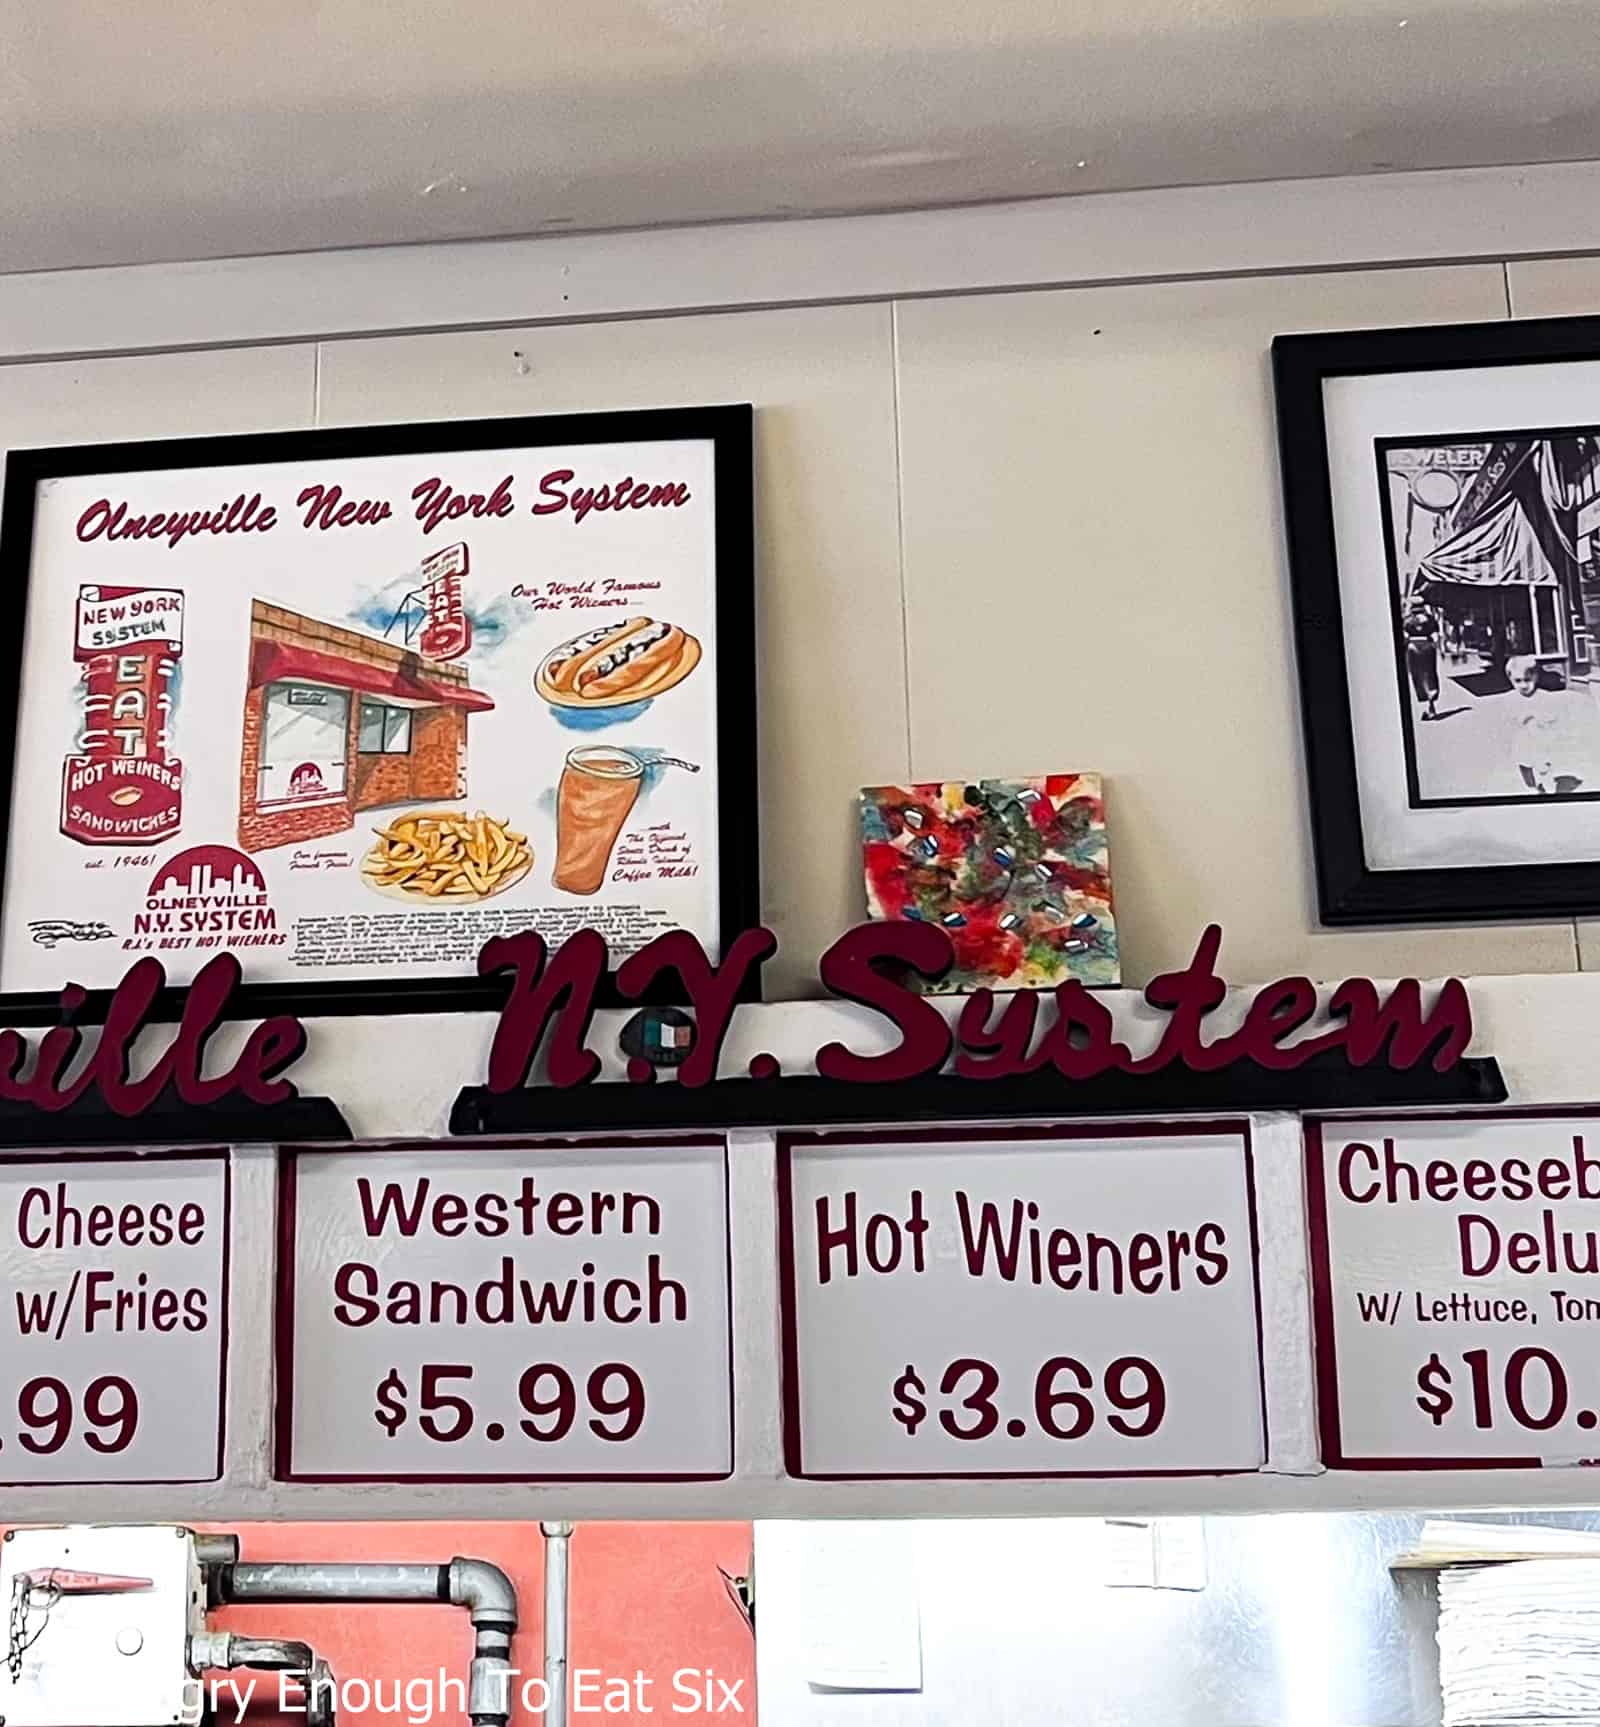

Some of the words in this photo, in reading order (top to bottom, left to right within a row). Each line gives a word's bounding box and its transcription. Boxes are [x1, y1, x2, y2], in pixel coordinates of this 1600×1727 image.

[76, 493, 277, 548] Olneyville
[297, 484, 392, 531] New
[412, 474, 514, 534] York
[531, 469, 690, 524] System
[84, 606, 126, 625] NEW
[511, 583, 538, 597] Our
[546, 580, 596, 596] World
[602, 578, 660, 594] Famous
[531, 597, 562, 611] Hot
[113, 655, 147, 755] EAT
[72, 763, 107, 791] HOT
[112, 759, 181, 791] WEINERS
[70, 805, 178, 832] SANDWICHES
[114, 854, 157, 868] 1946!
[612, 868, 652, 882] Coffee
[134, 913, 173, 934] N.Y.
[179, 908, 276, 932] SYSTEM
[146, 894, 268, 910] OLNEYVILLE
[159, 937, 192, 949] BEST
[196, 935, 222, 947] HOT
[478, 927, 781, 1093] N.Y.
[816, 920, 1473, 1084] System
[18, 1182, 205, 1248] Cheese
[357, 1176, 660, 1238] Western
[815, 1190, 929, 1284] Hot
[954, 1190, 1230, 1295] Wieners
[1458, 1209, 1599, 1277] Delu
[16, 1270, 208, 1340] w/Fries
[333, 1255, 688, 1328] Sandwich
[1357, 1291, 1402, 1325] W/
[1416, 1291, 1537, 1325] Lettuce,
[0, 1375, 138, 1453] 99
[374, 1363, 646, 1443] $5.99
[892, 1356, 1167, 1441] $3.69
